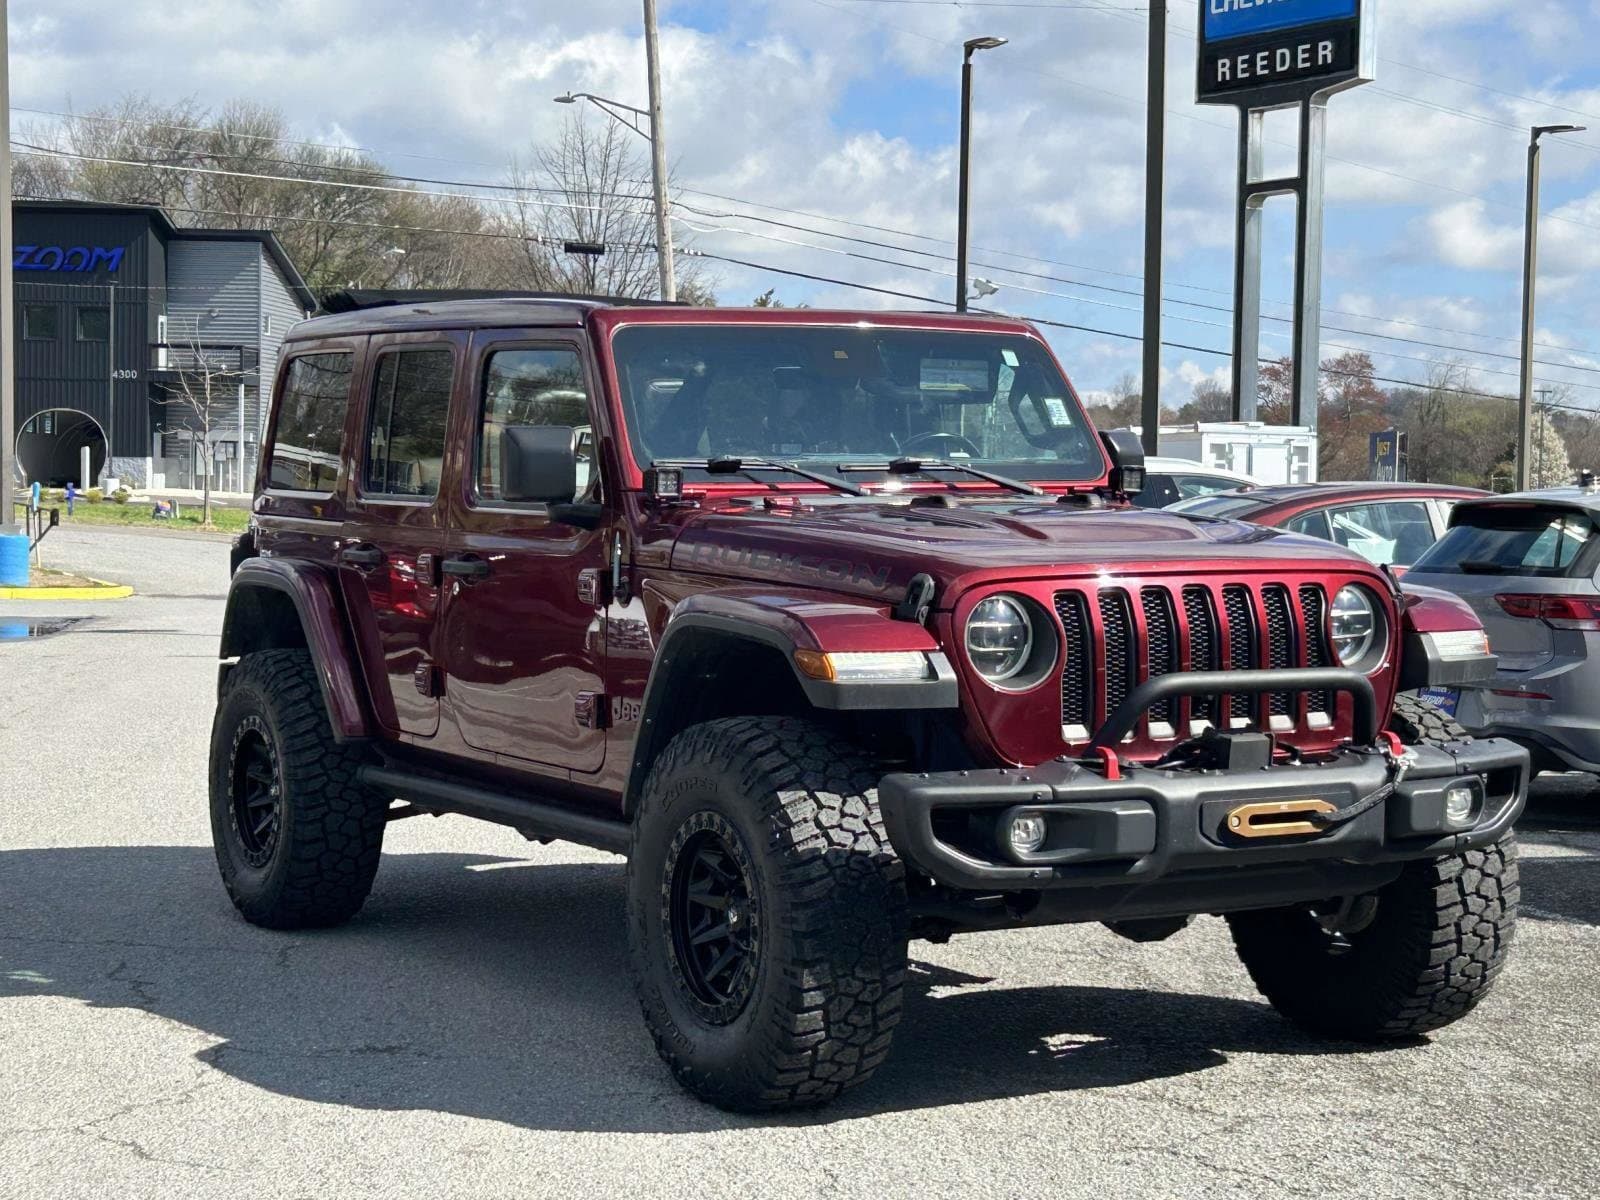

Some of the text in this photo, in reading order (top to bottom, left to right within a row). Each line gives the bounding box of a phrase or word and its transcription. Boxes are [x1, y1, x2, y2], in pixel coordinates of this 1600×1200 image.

[1217, 40, 1332, 82] REEDER
[14, 245, 125, 272] ZOOM
[112, 369, 138, 379] 4300
[691, 541, 892, 588] RUBICON
[614, 696, 642, 721] Jee
